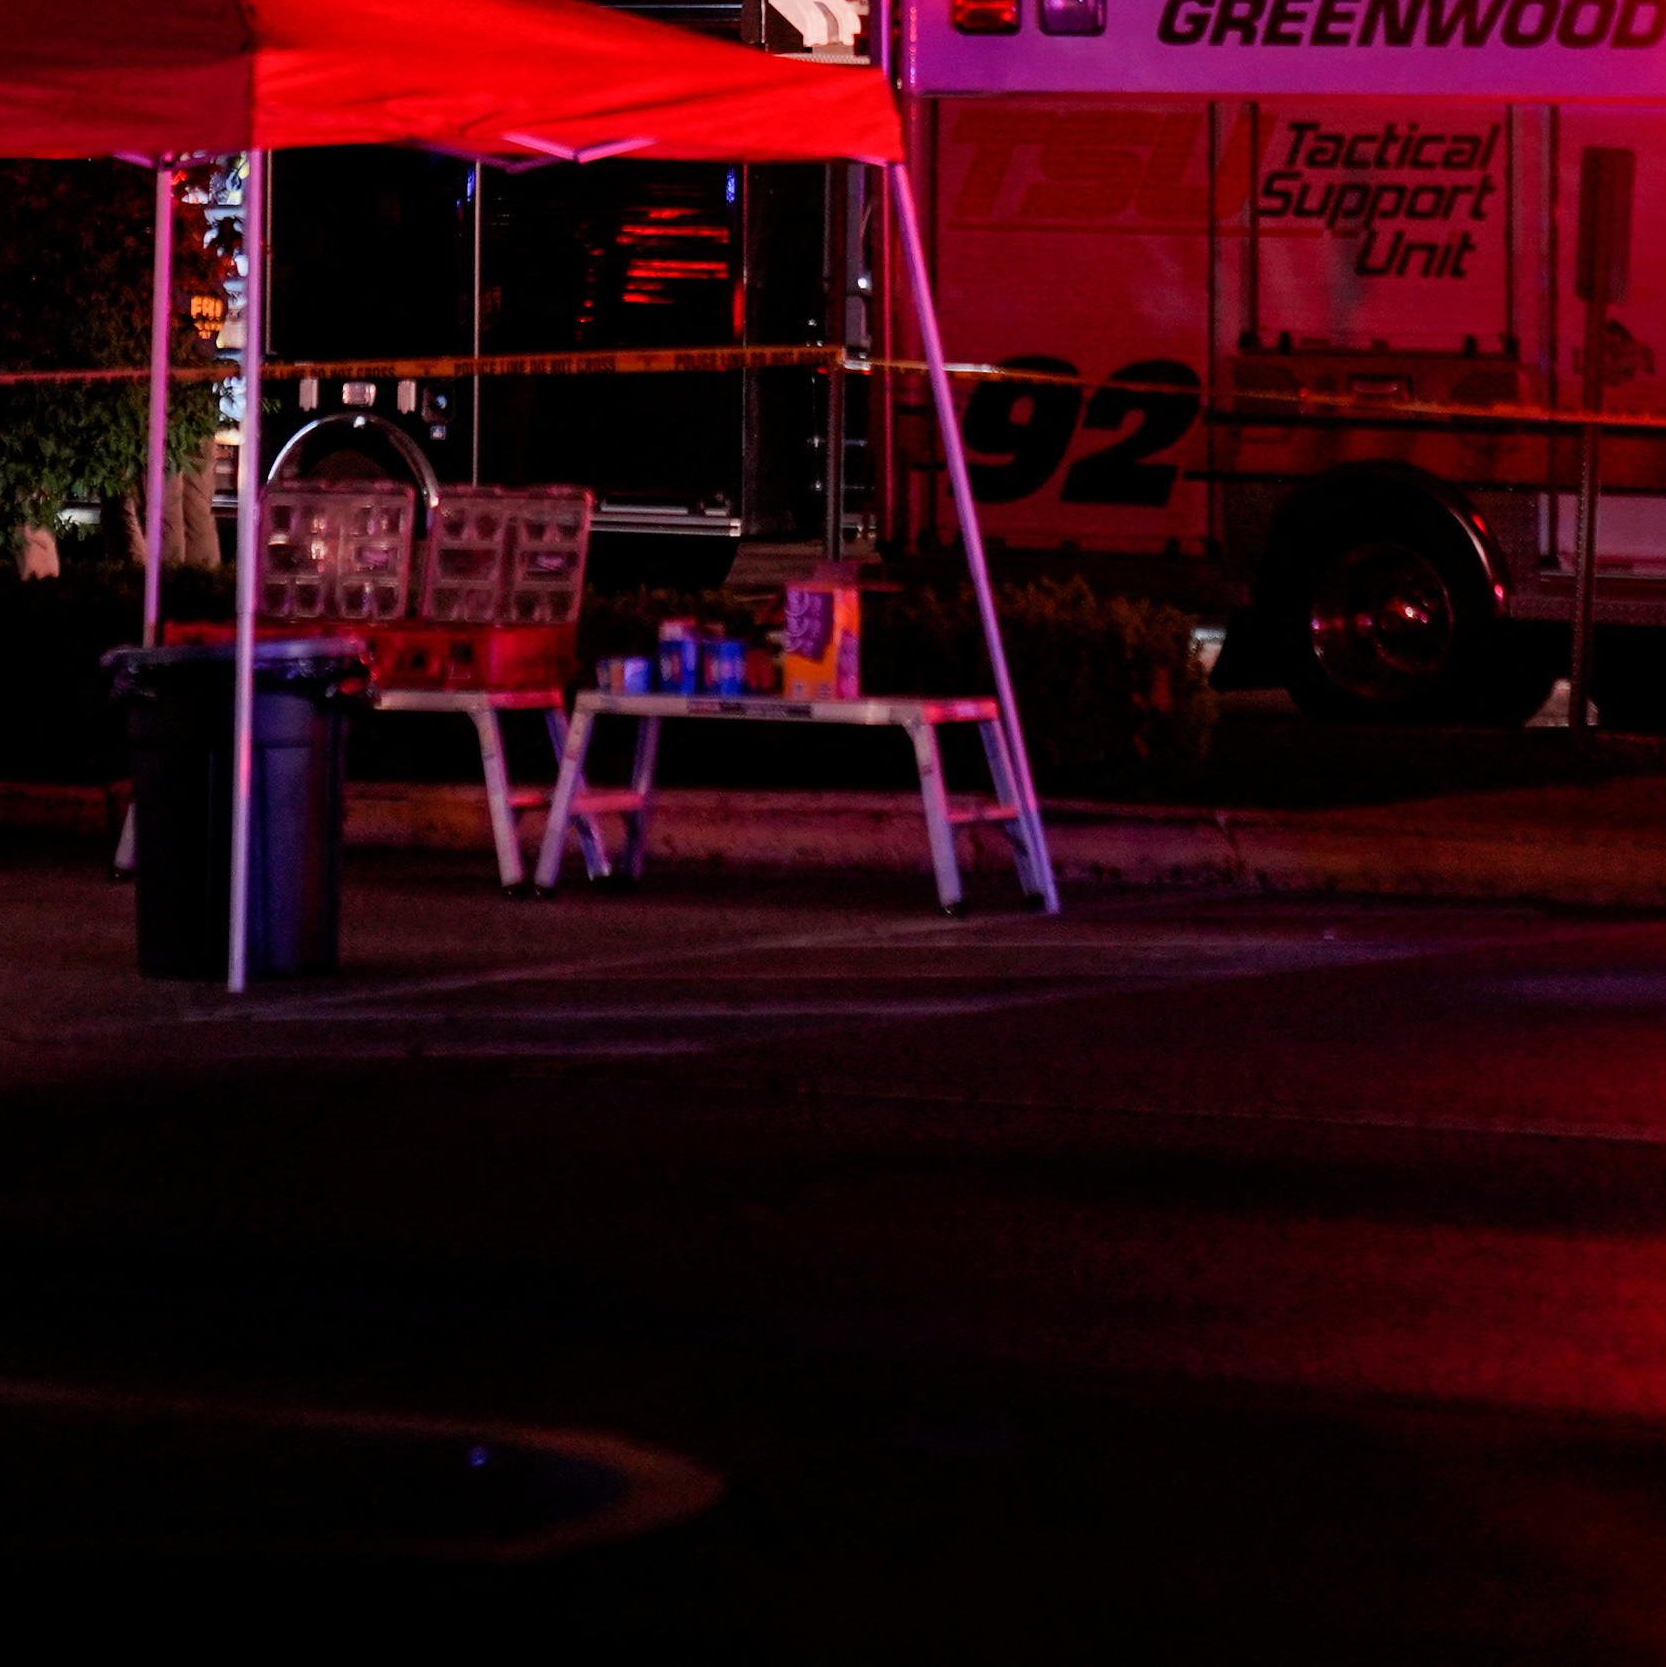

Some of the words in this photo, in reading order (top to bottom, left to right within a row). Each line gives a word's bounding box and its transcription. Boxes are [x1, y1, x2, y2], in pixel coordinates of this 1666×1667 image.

[1284, 120, 1502, 171] Tactical
[1257, 171, 1494, 231] Support
[1354, 230, 1478, 279] Unit
[948, 355, 1201, 508] 92
